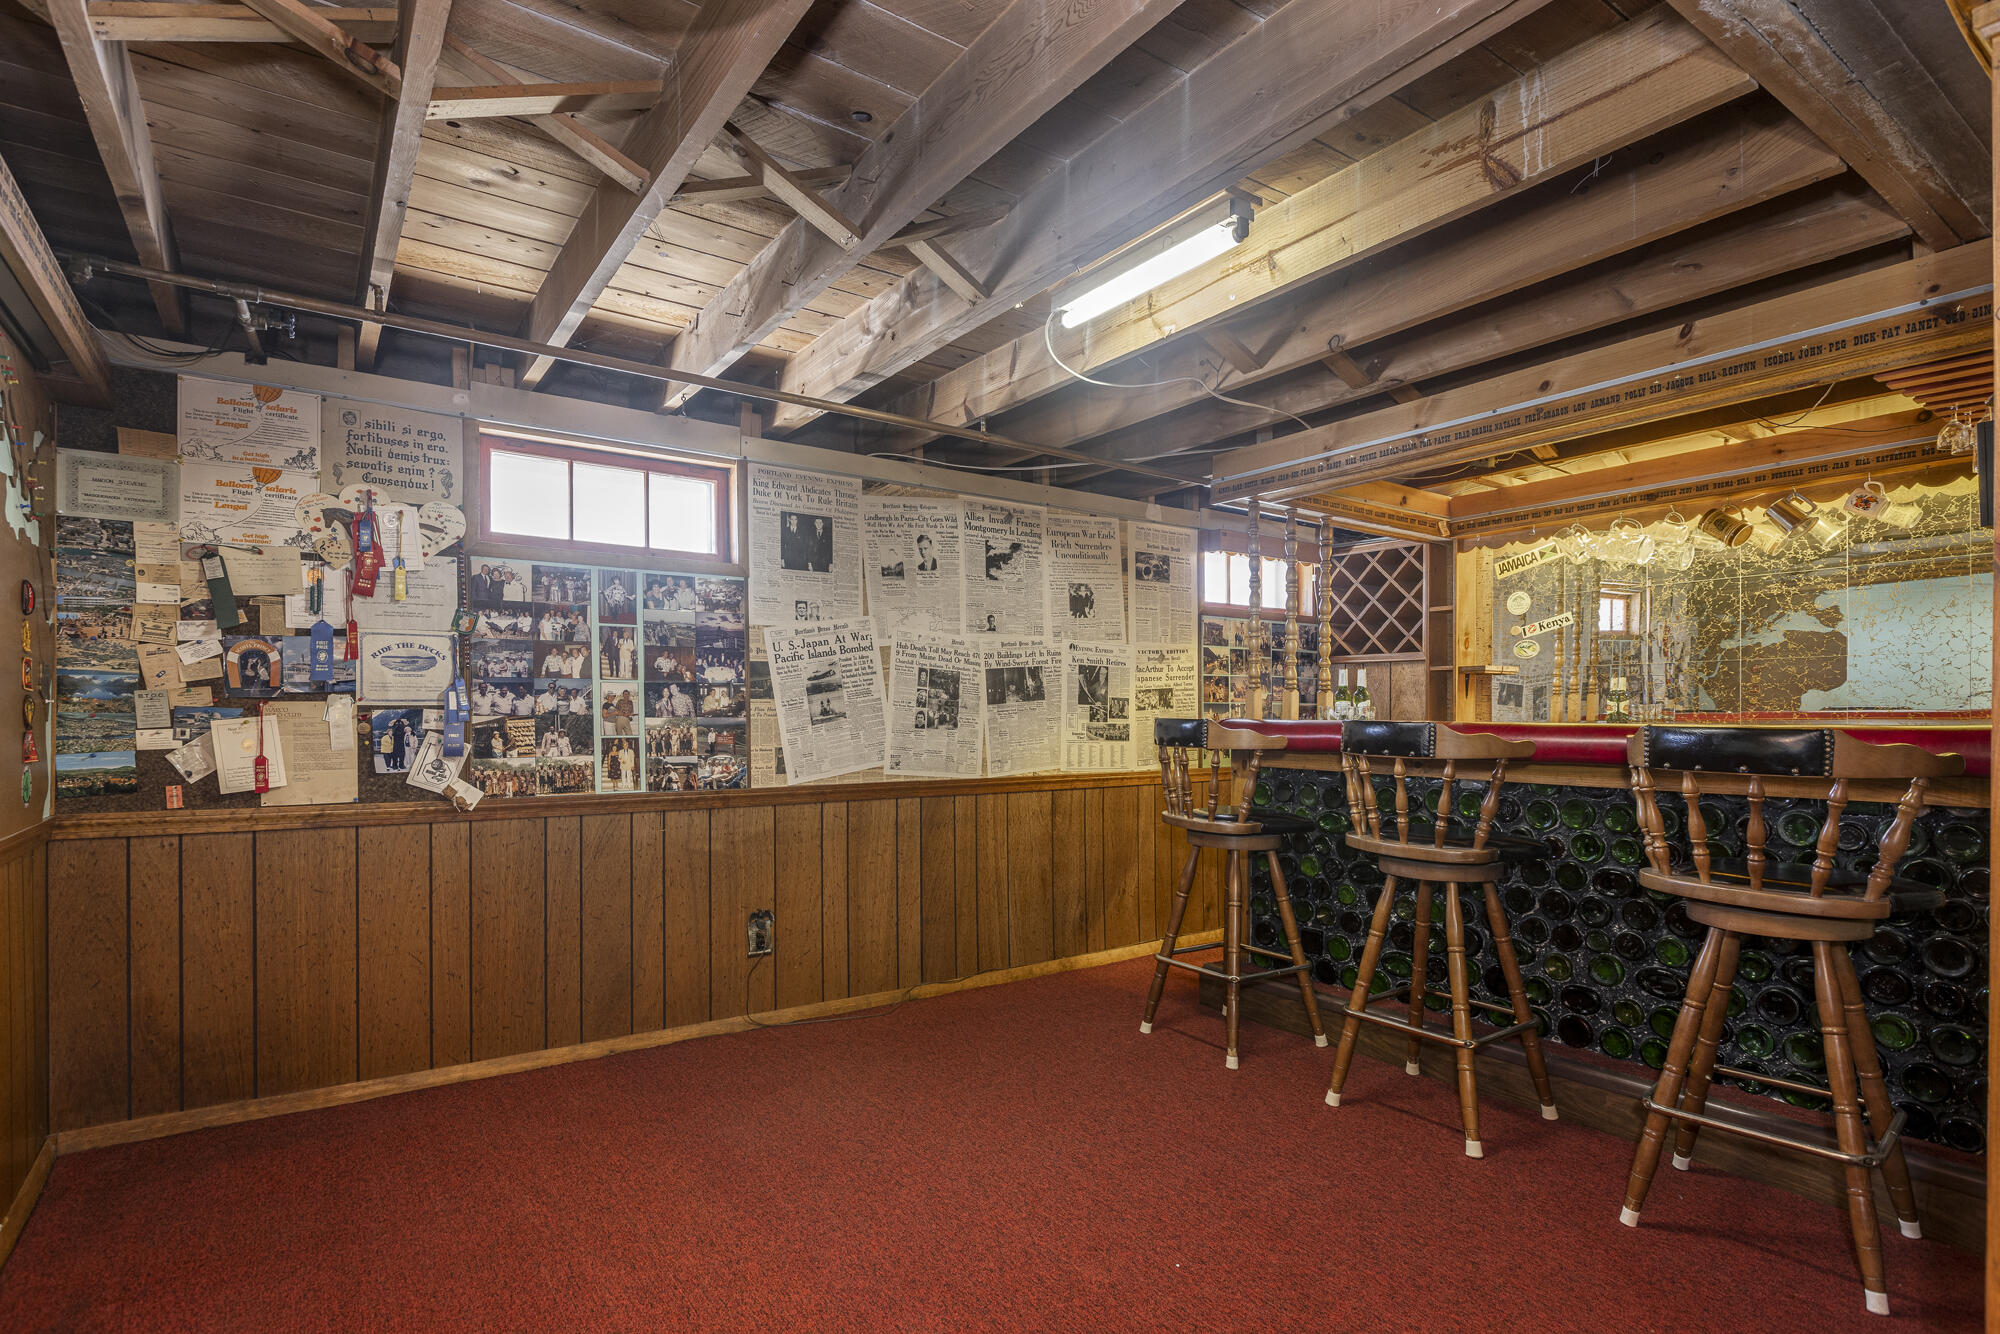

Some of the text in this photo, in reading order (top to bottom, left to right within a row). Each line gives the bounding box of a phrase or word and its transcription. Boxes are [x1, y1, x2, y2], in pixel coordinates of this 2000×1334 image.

[1495, 418, 1521, 431] NATALIE
[1573, 401, 1586, 413] LOU
[1590, 394, 1621, 409] ARMAND
[1624, 387, 1646, 401] POLLY
[1764, 351, 1795, 367] ISOBEL
[1905, 317, 1939, 333] JANET
[216, 397, 298, 414] Balloon safaris
[265, 411, 299, 420] certificate
[402, 425, 412, 435] si
[413, 439, 424, 451] in
[346, 442, 383, 458] Nobili
[388, 447, 420, 464] demis
[119, 480, 147, 488] STEVENS
[758, 469, 854, 487] PORTLAND EVENING EXPRESS
[216, 480, 297, 494] Balloon safaris
[752, 478, 770, 489] King
[772, 480, 798, 492] Edward
[800, 485, 832, 496] Abdicates
[264, 493, 298, 501] certificate
[752, 487, 859, 509] Duke Of York To Rule Britain
[864, 513, 893, 523] Lindbergh
[964, 511, 985, 522] Allies
[1015, 517, 1041, 529] France
[964, 521, 1042, 539] Montgomery Is Leading
[1046, 527, 1116, 540] European War Ends!
[1051, 539, 1112, 551] Reich Surrenders
[1055, 549, 1109, 561] Unconditionally
[1499, 552, 1539, 576] JAMAICA
[794, 623, 849, 636] Portland Press Herald
[1522, 616, 1571, 637] I Kenya
[772, 641, 784, 653] U.
[834, 634, 846, 644] At
[896, 641, 909, 650] Hub
[910, 643, 927, 653] Death
[928, 646, 940, 654] Toll
[940, 647, 953, 657] May
[953, 649, 971, 658] Reach
[370, 645, 395, 660] RIDE
[417, 643, 448, 661] DUCKS
[774, 641, 874, 665] Pacific Islands Bombed
[901, 650, 918, 659] From
[919, 652, 937, 661] Maine
[938, 655, 953, 663] Dead
[963, 658, 981, 667] Missing
[983, 652, 995, 660] 200
[997, 651, 1023, 660] Buildings
[1024, 650, 1037, 658] Left
[1046, 649, 1062, 657] Ruins
[984, 660, 993, 668] By
[995, 659, 1030, 668] Wind-Swept
[1031, 658, 1049, 666] Forest
[1071, 655, 1127, 667] Ken Smith Retires
[1166, 664, 1175, 672] To
[1176, 664, 1195, 672] Accept
[1165, 673, 1195, 682] Surrender
